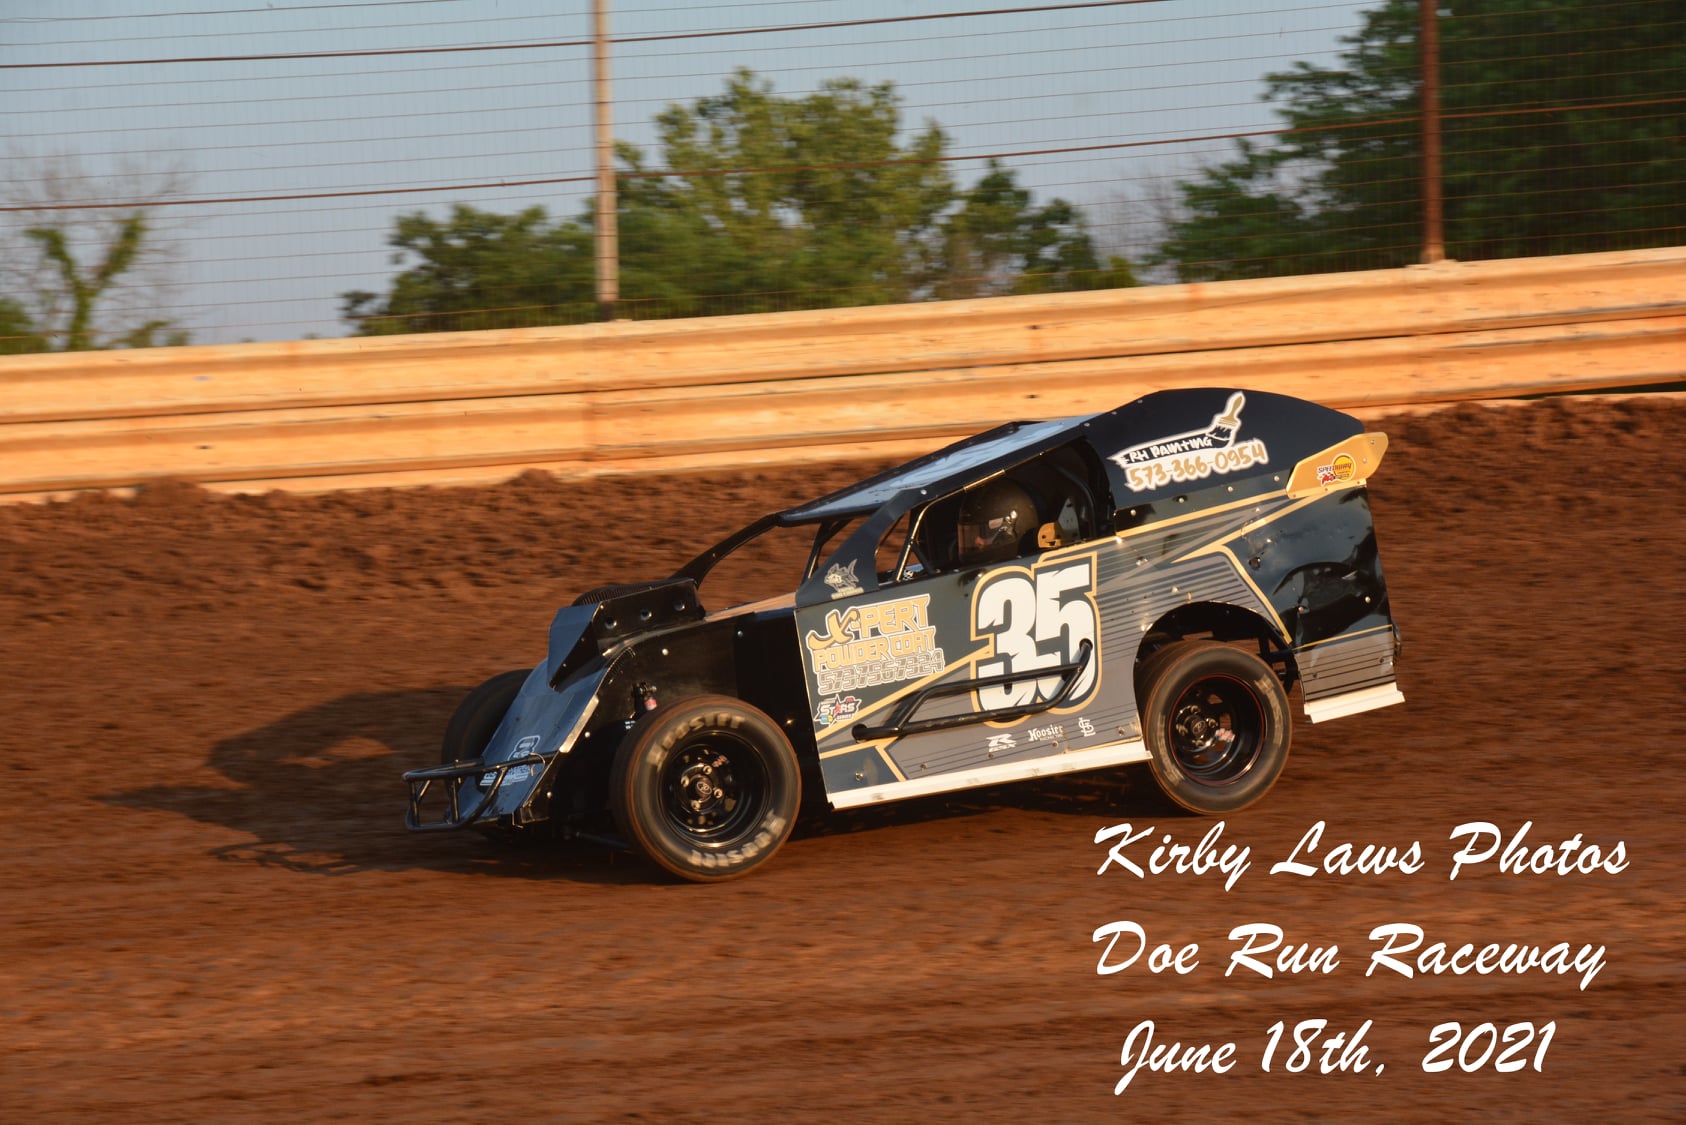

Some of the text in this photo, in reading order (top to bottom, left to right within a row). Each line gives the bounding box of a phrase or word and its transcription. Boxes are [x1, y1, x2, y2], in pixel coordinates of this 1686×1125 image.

[1129, 448, 1149, 463] RH
[1129, 443, 1266, 486] 573-366-0954
[814, 628, 936, 672] POWDER COAT
[978, 563, 1096, 712] 35
[1027, 724, 1063, 742] Hoosier
